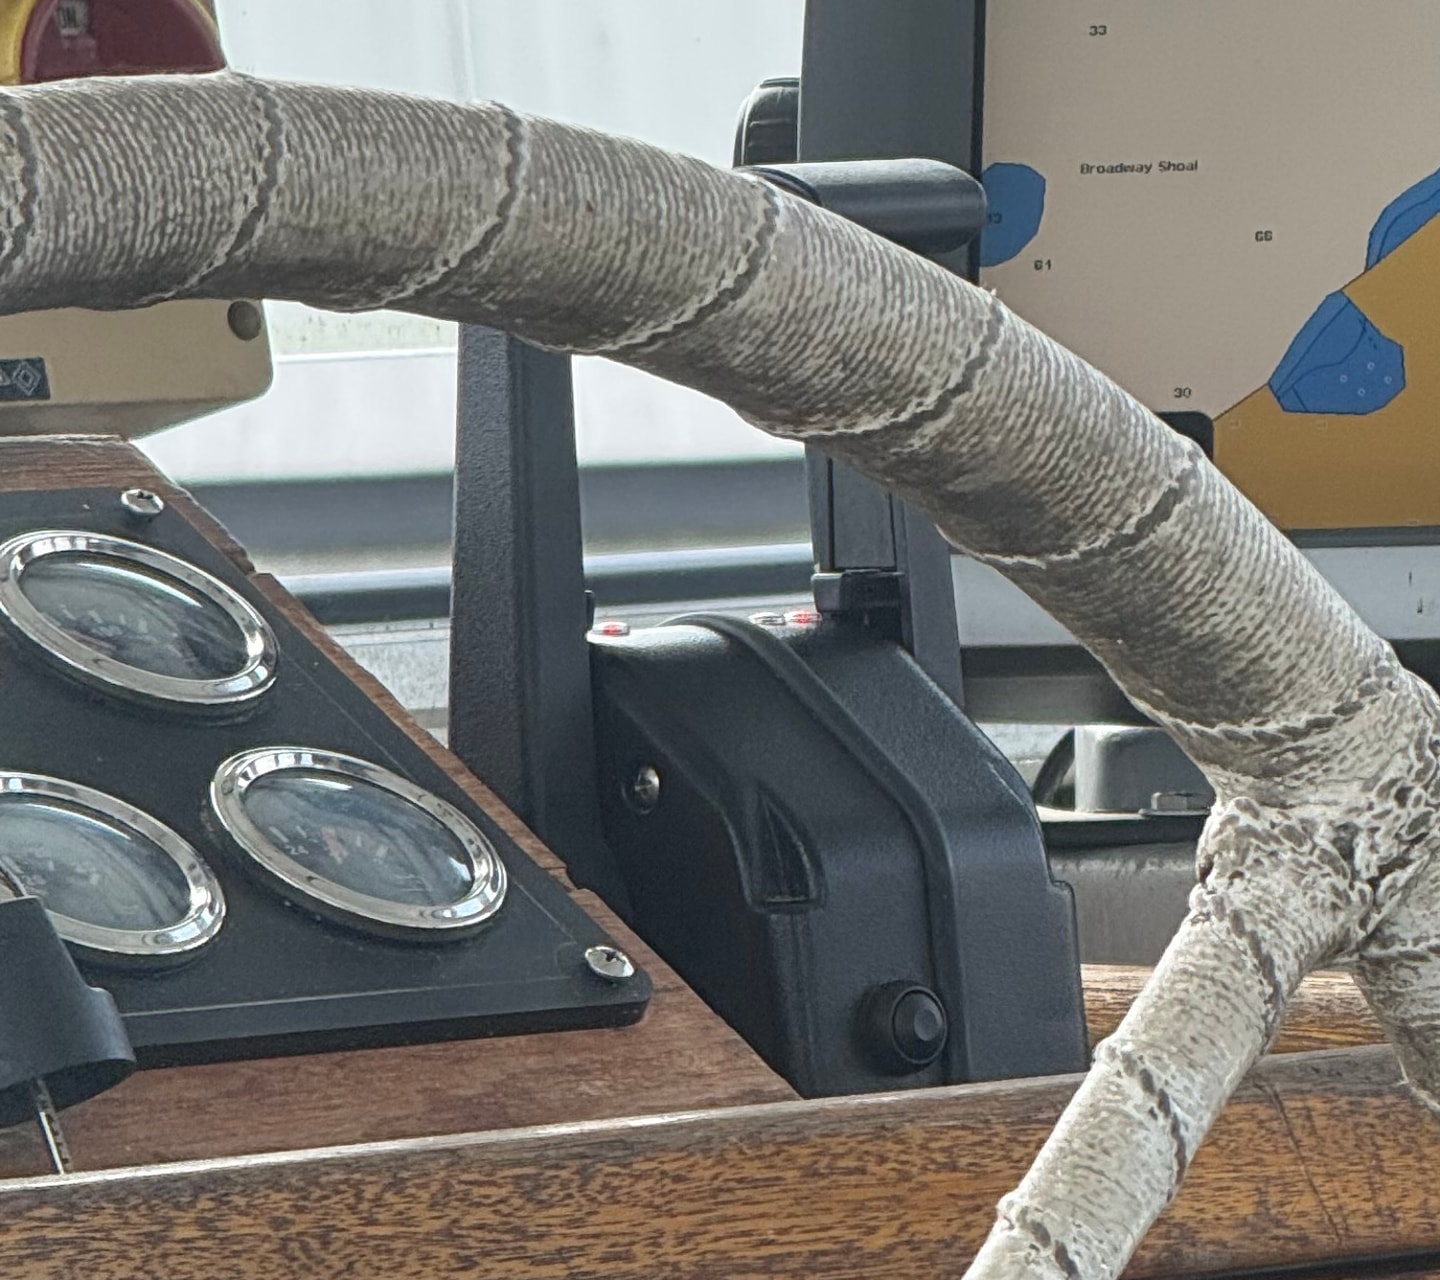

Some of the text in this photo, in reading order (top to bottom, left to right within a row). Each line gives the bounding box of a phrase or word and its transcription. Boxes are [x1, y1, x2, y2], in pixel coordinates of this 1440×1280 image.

[1089, 25, 1108, 36] 33
[1080, 160, 1198, 175] Broadway Shoal
[1174, 388, 1192, 400] 30
